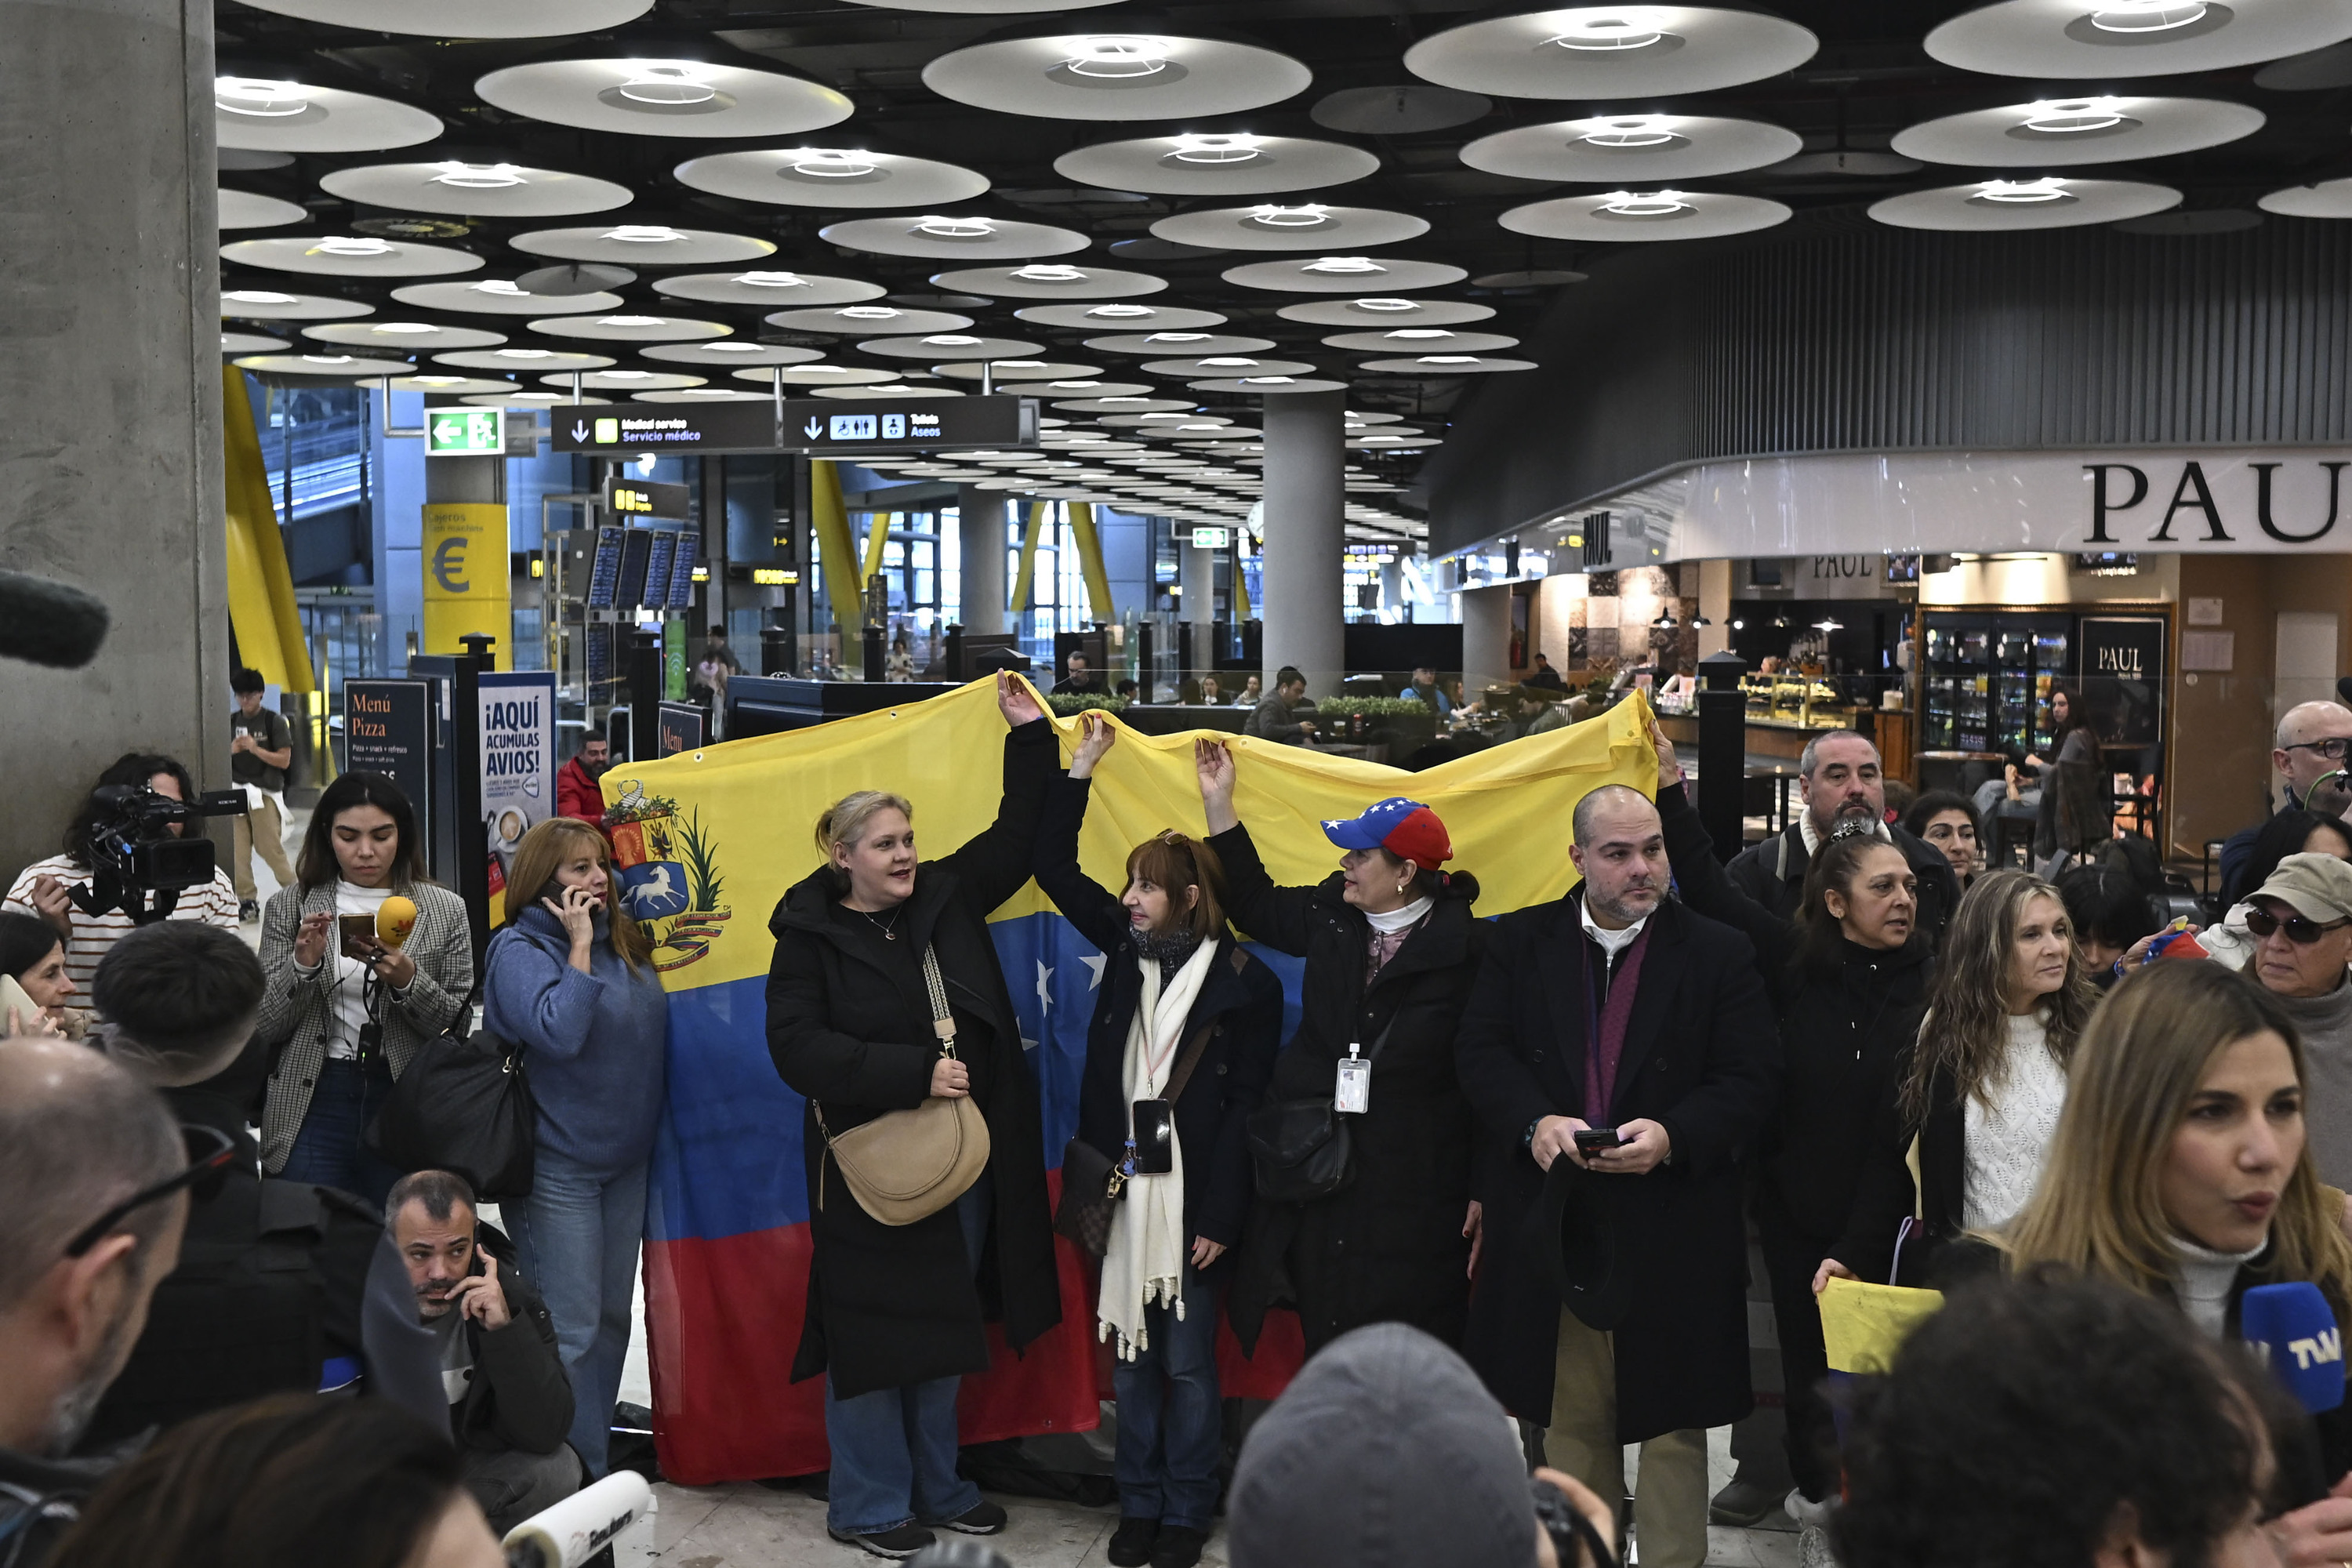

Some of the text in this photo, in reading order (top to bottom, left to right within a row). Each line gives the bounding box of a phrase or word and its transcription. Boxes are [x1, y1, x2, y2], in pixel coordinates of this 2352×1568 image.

[622, 430, 701, 442] Servicio médico
[910, 426, 941, 437] Aseos
[2082, 461, 2351, 543] PAU
[1813, 556, 1872, 579] PAUL
[2099, 647, 2143, 672] PAUL
[352, 694, 391, 713] Menú
[486, 695, 539, 732] ¡AQUÍ
[352, 717, 387, 737] Pizza
[387, 745, 408, 753] refresco
[486, 732, 540, 750] ACUMULAS
[662, 725, 683, 752] Menú
[486, 750, 540, 776] AVIOS!
